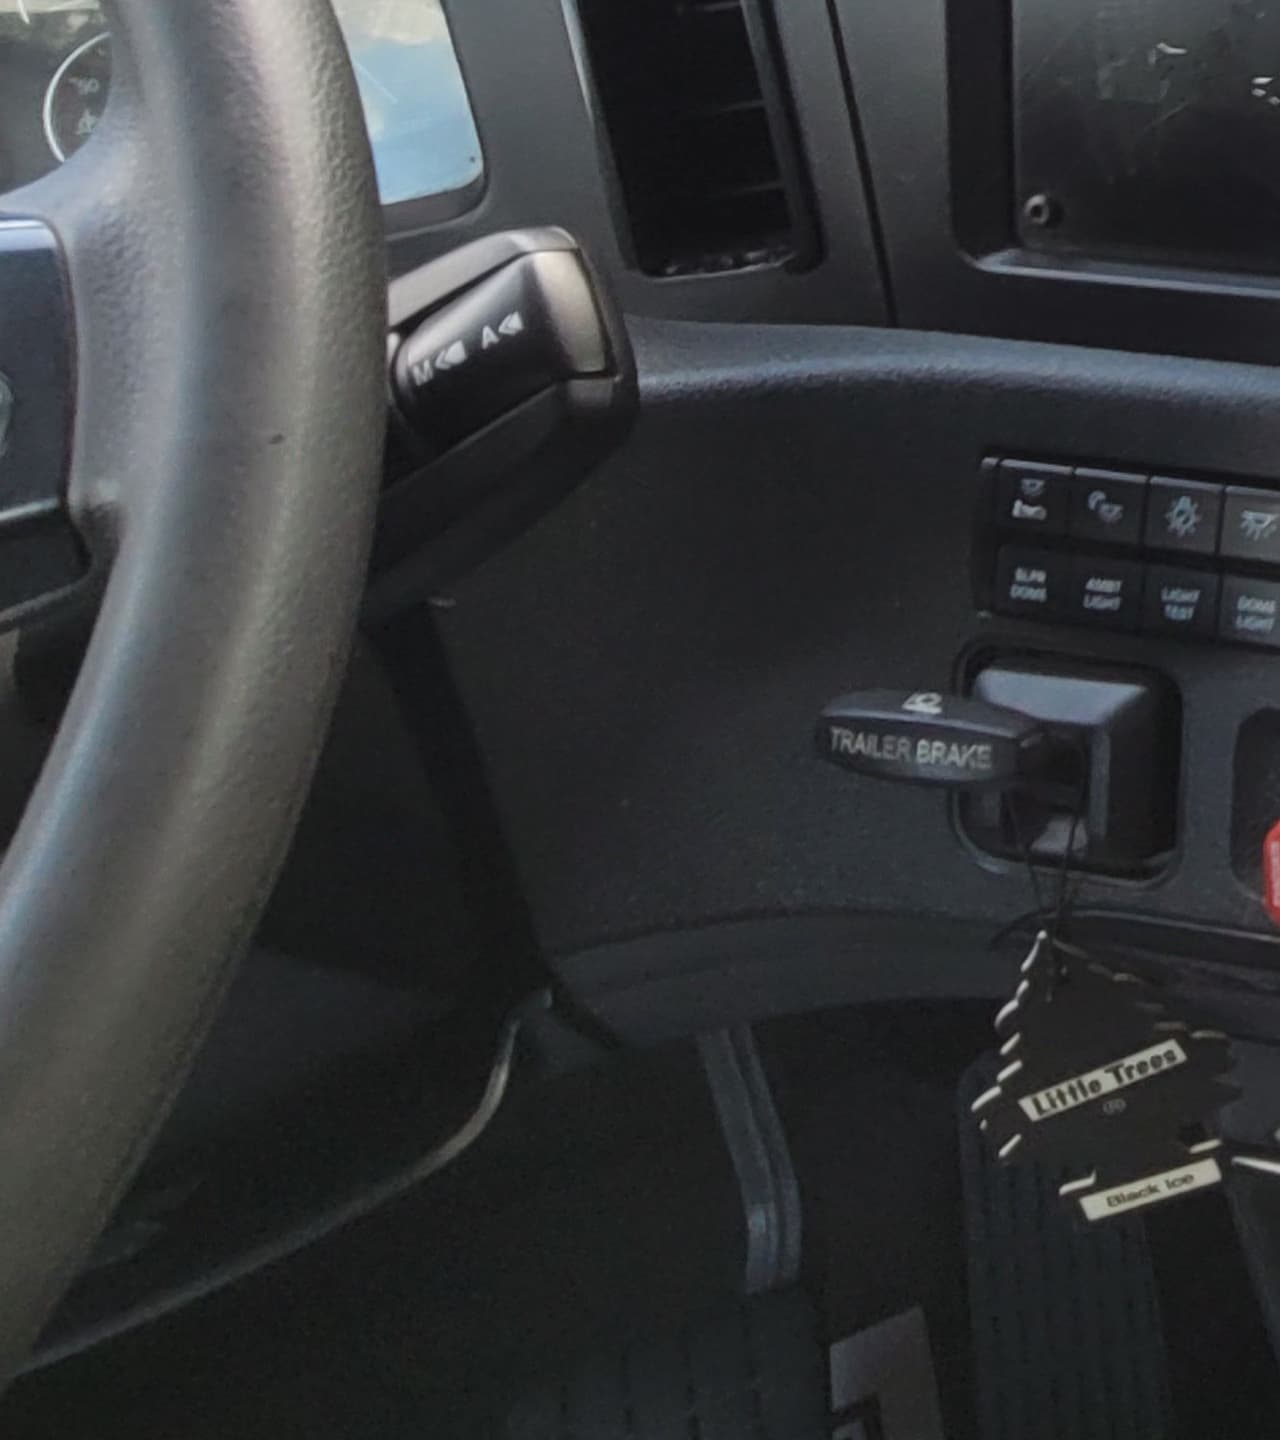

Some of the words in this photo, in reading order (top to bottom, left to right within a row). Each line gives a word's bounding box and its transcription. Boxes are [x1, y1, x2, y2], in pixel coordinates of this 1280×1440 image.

[830, 725, 911, 761] TRAILER
[915, 738, 993, 769] BRAKE
[1030, 1077, 1103, 1116] Little
[1105, 1048, 1178, 1087] Trees
[1105, 1182, 1161, 1208] Black
[1164, 1172, 1195, 1192] Ice
